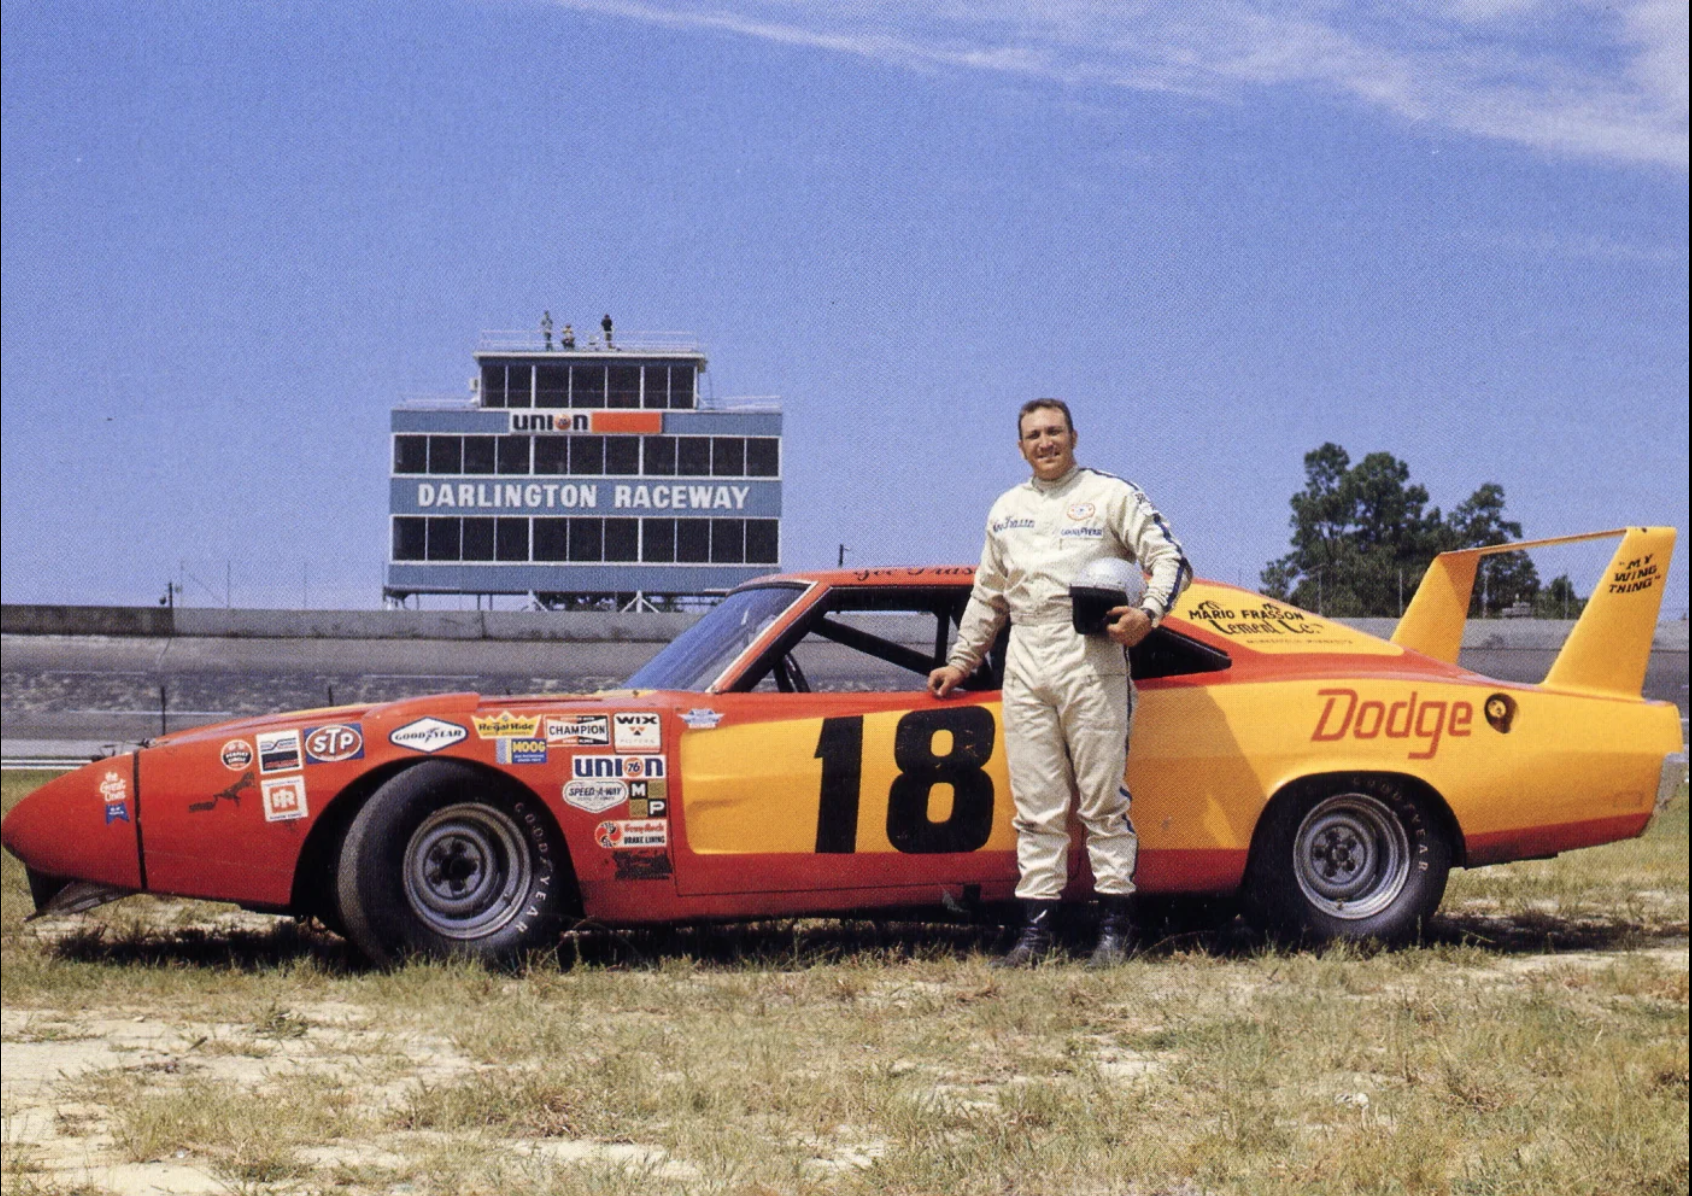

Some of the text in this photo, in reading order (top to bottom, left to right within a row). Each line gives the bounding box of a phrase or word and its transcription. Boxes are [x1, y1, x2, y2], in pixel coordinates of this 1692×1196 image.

[418, 483, 751, 510] DARLINGTON RACEWAY
[1614, 564, 1658, 582] WING
[1188, 609, 1305, 621] MARIO FRASSON
[616, 716, 658, 725] WIX
[1310, 688, 1474, 760] Dodge
[394, 728, 463, 743] GOODYEAR
[548, 725, 606, 736] CHAMPION
[313, 728, 354, 754] STP
[512, 741, 546, 753] MOOG
[628, 762, 641, 773] 76
[813, 705, 996, 854] 18
[631, 783, 646, 797] M
[649, 801, 665, 815] P
[514, 802, 554, 933] GOODYEAR
